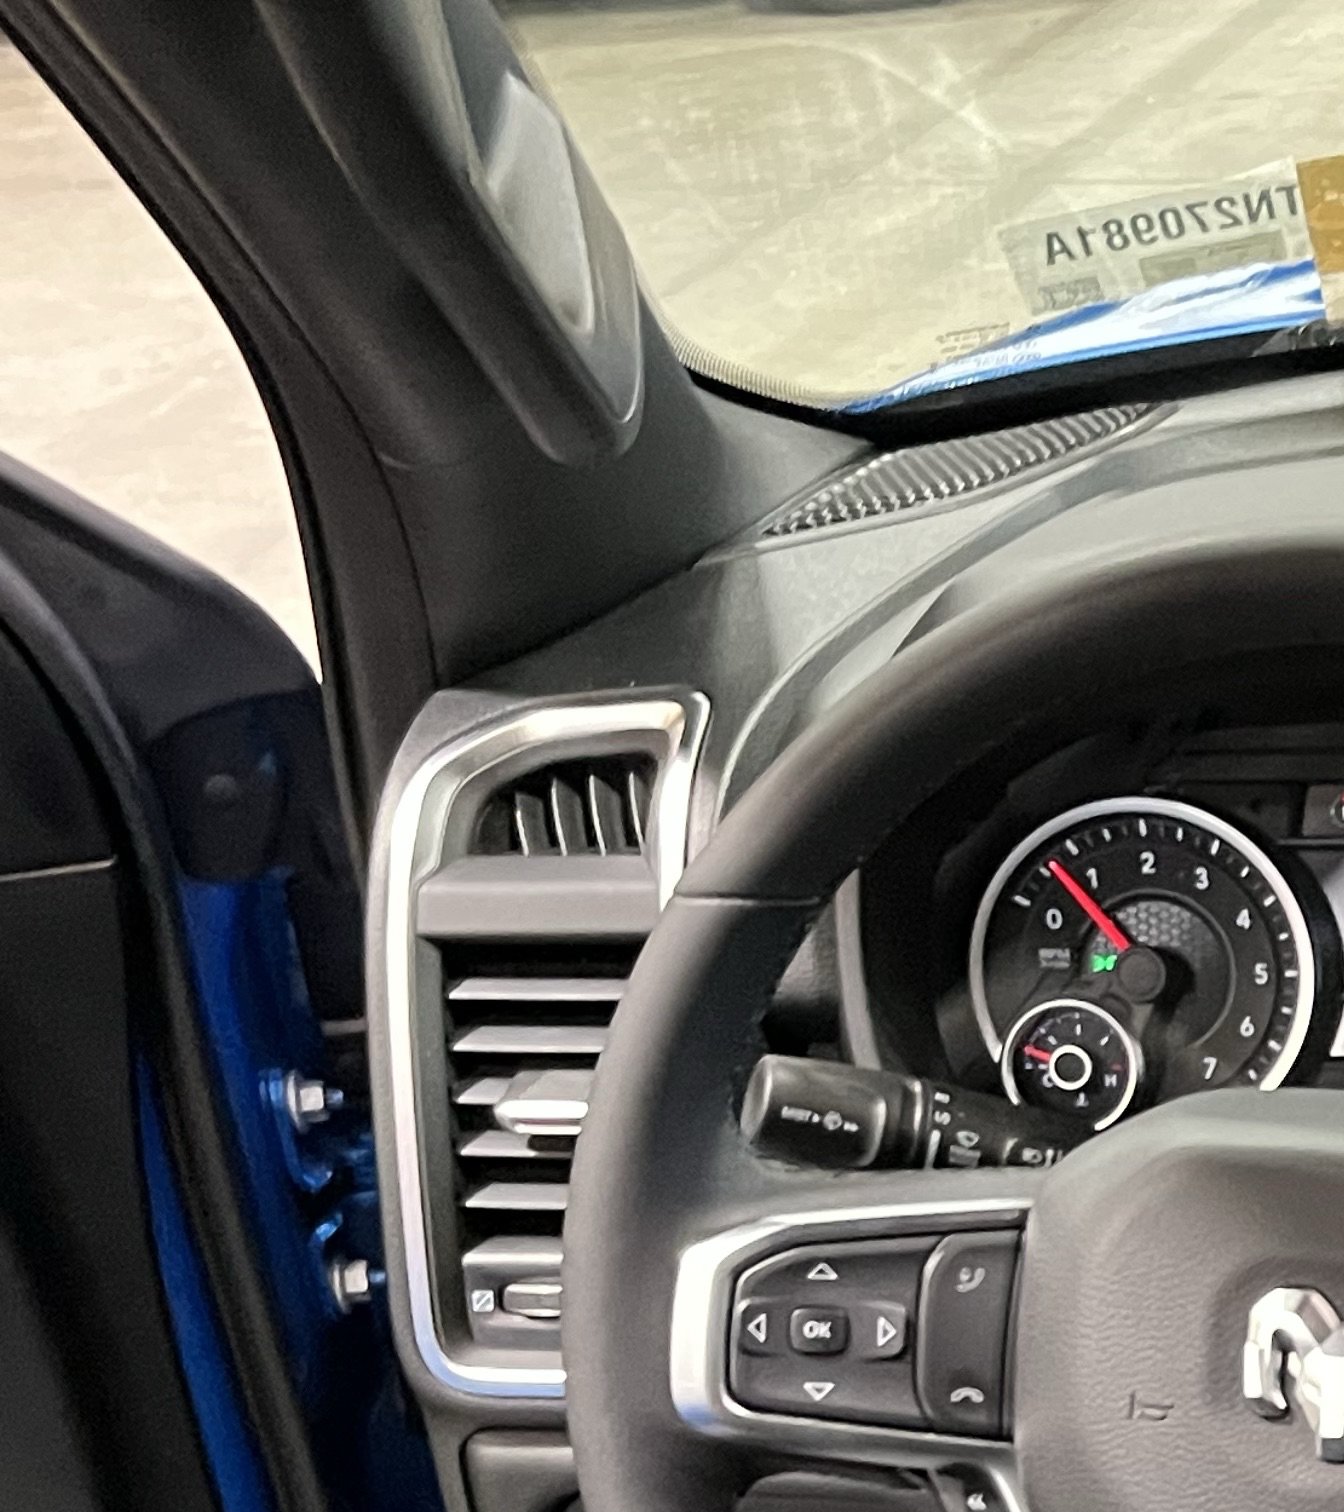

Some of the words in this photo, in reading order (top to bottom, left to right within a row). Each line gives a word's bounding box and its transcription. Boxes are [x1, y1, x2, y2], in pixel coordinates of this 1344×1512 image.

[1139, 851, 1156, 875] 2
[1086, 867, 1098, 889] 1
[1195, 867, 1210, 890] 3
[1046, 909, 1063, 930] 0
[1236, 908, 1251, 930] 4
[1254, 962, 1269, 985] 5
[1240, 1016, 1255, 1037] 6
[1203, 1057, 1218, 1080] 7
[803, 1321, 832, 1339] OK
